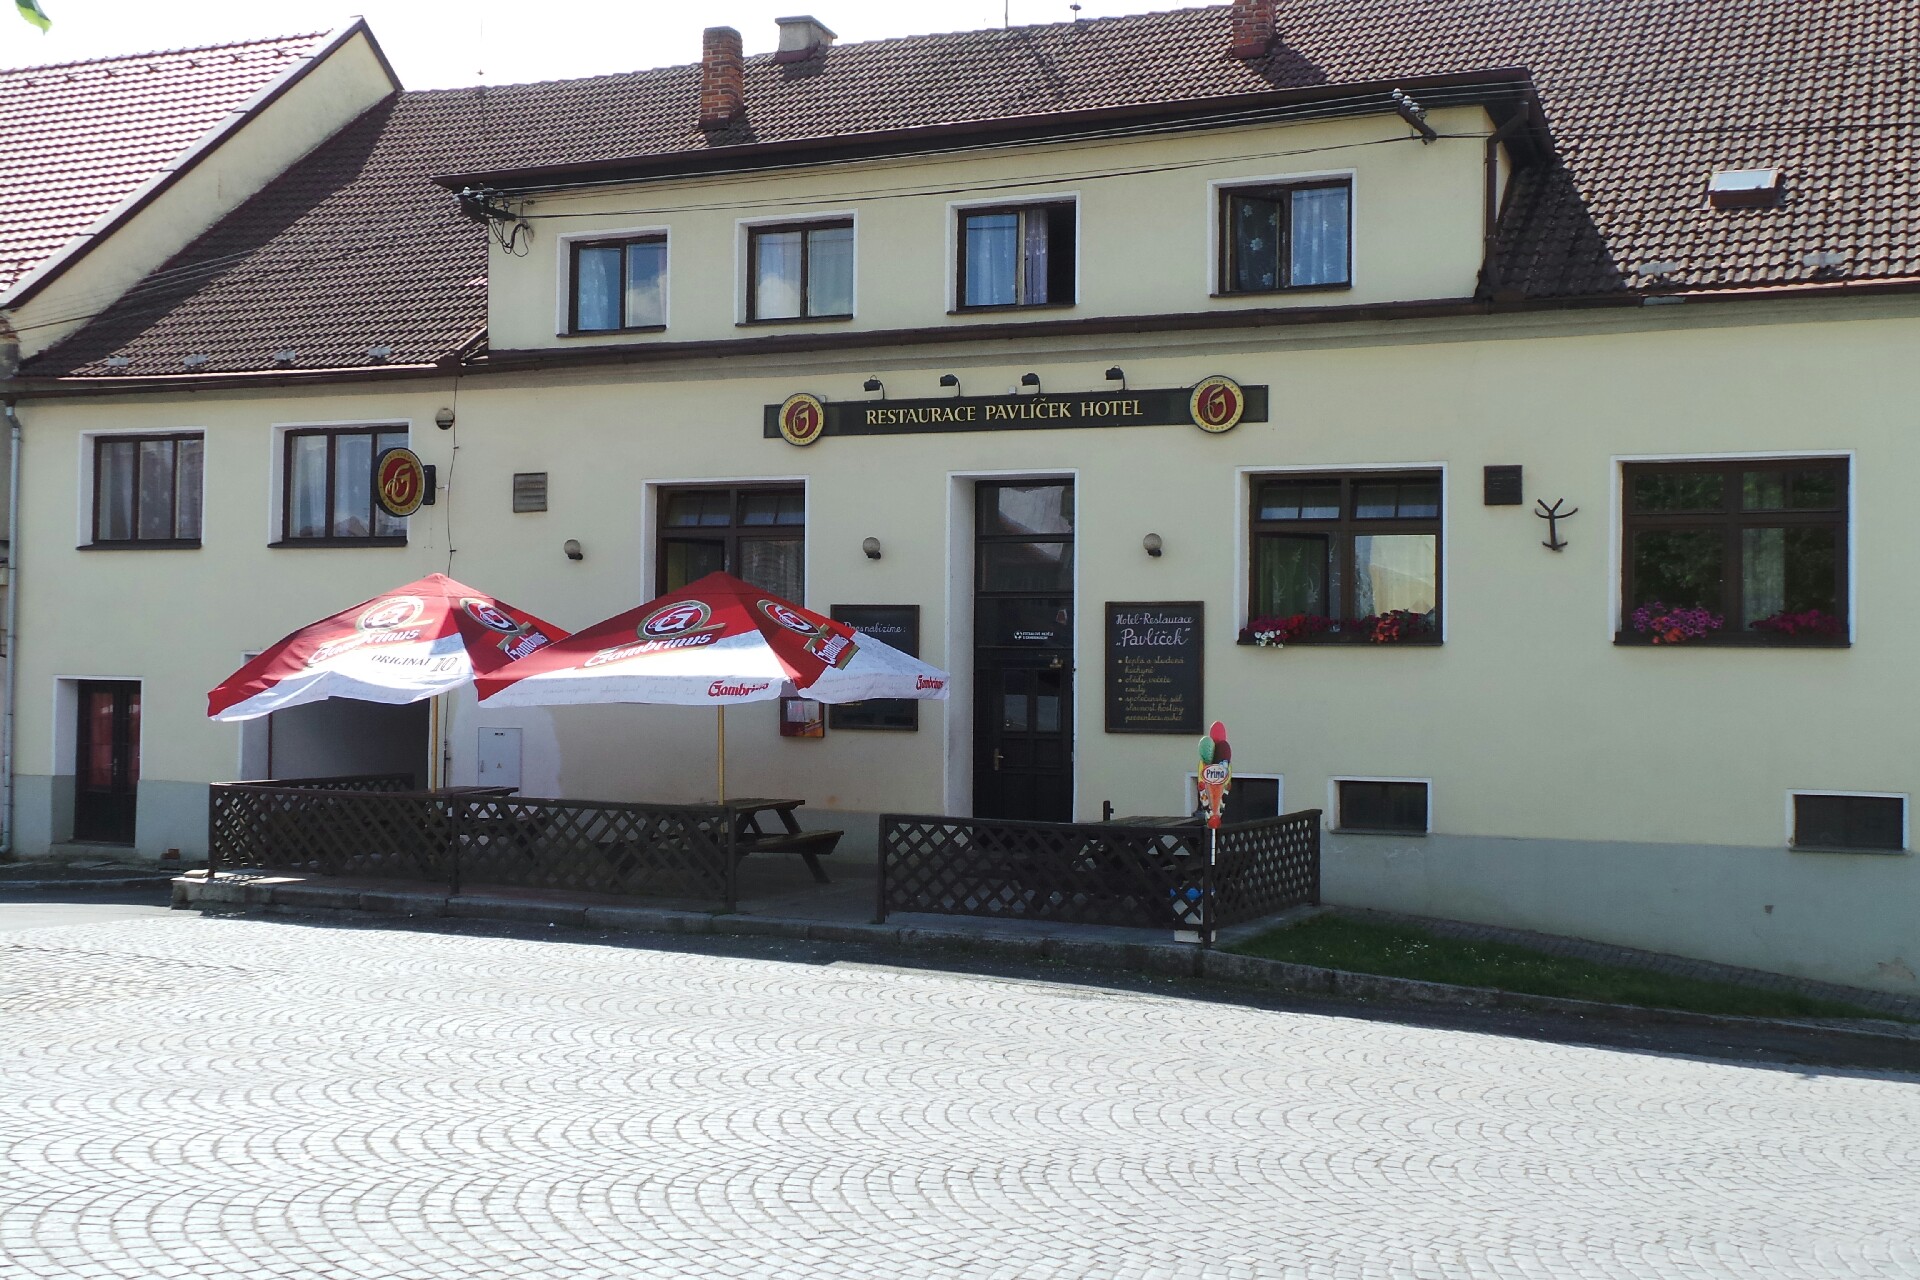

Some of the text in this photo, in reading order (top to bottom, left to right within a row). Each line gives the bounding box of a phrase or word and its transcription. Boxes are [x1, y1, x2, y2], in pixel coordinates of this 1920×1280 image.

[866, 397, 1144, 425] RESTAURACE PAVLÍČEK HOTEL
[583, 633, 713, 668] Gambrinus
[1206, 768, 1225, 779] Prima
